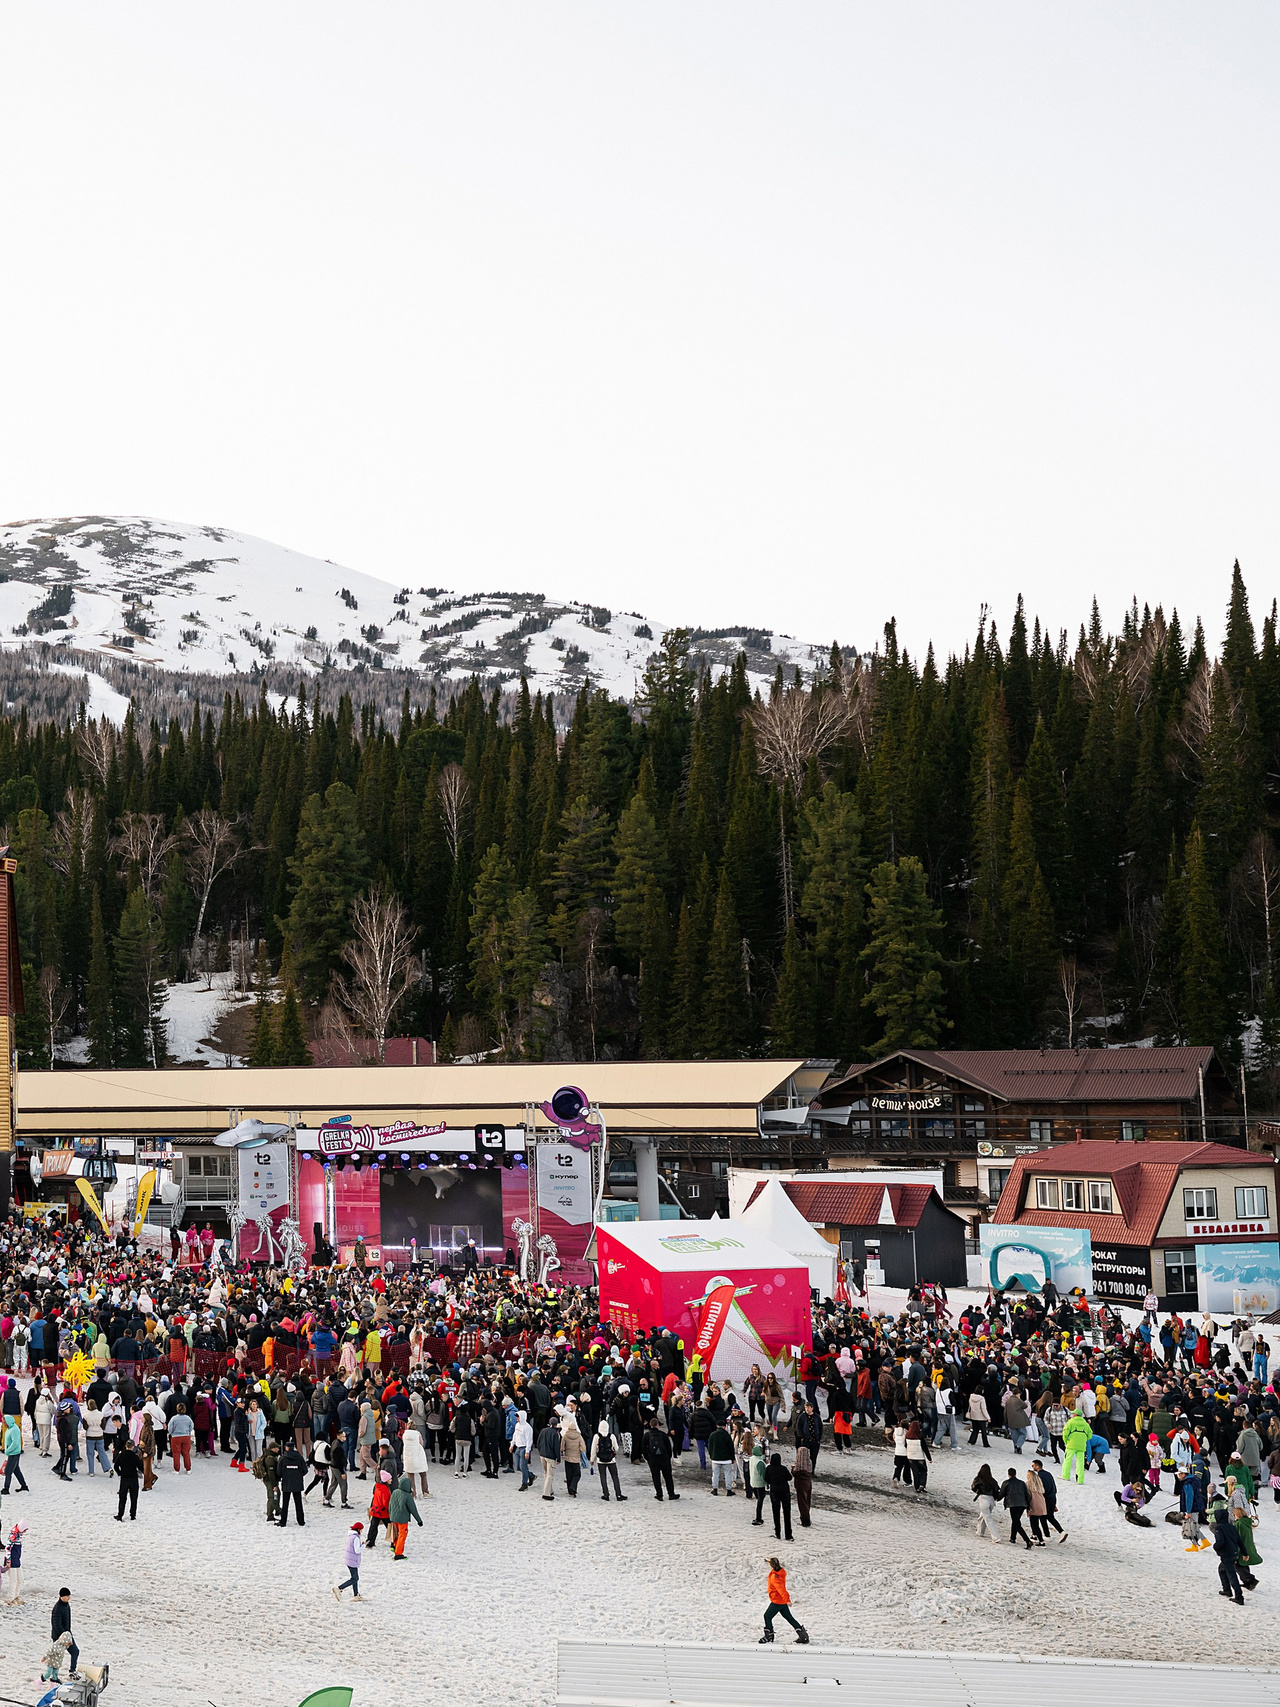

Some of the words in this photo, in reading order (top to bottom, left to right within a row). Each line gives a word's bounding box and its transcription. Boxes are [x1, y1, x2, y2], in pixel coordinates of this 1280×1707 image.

[378, 1121, 414, 1135] первая
[324, 1131, 350, 1142] GRELKA
[478, 1129, 503, 1147] t2
[325, 1140, 343, 1150] FEST
[254, 1152, 271, 1165] t2
[555, 1153, 573, 1167] t2
[987, 1228, 1020, 1238] INVITRO
[1193, 1223, 1264, 1234] НЕВАЛЯШКА
[1091, 1251, 1117, 1260] РОКАТ
[1092, 1263, 1146, 1276] НСТРУКТОРЫ
[1093, 1280, 1107, 1293] 961
[1108, 1281, 1124, 1294] 700
[1124, 1283, 1135, 1296] 80
[1136, 1284, 1147, 1297] 40
[697, 1301, 723, 1349] ФИНИШ
